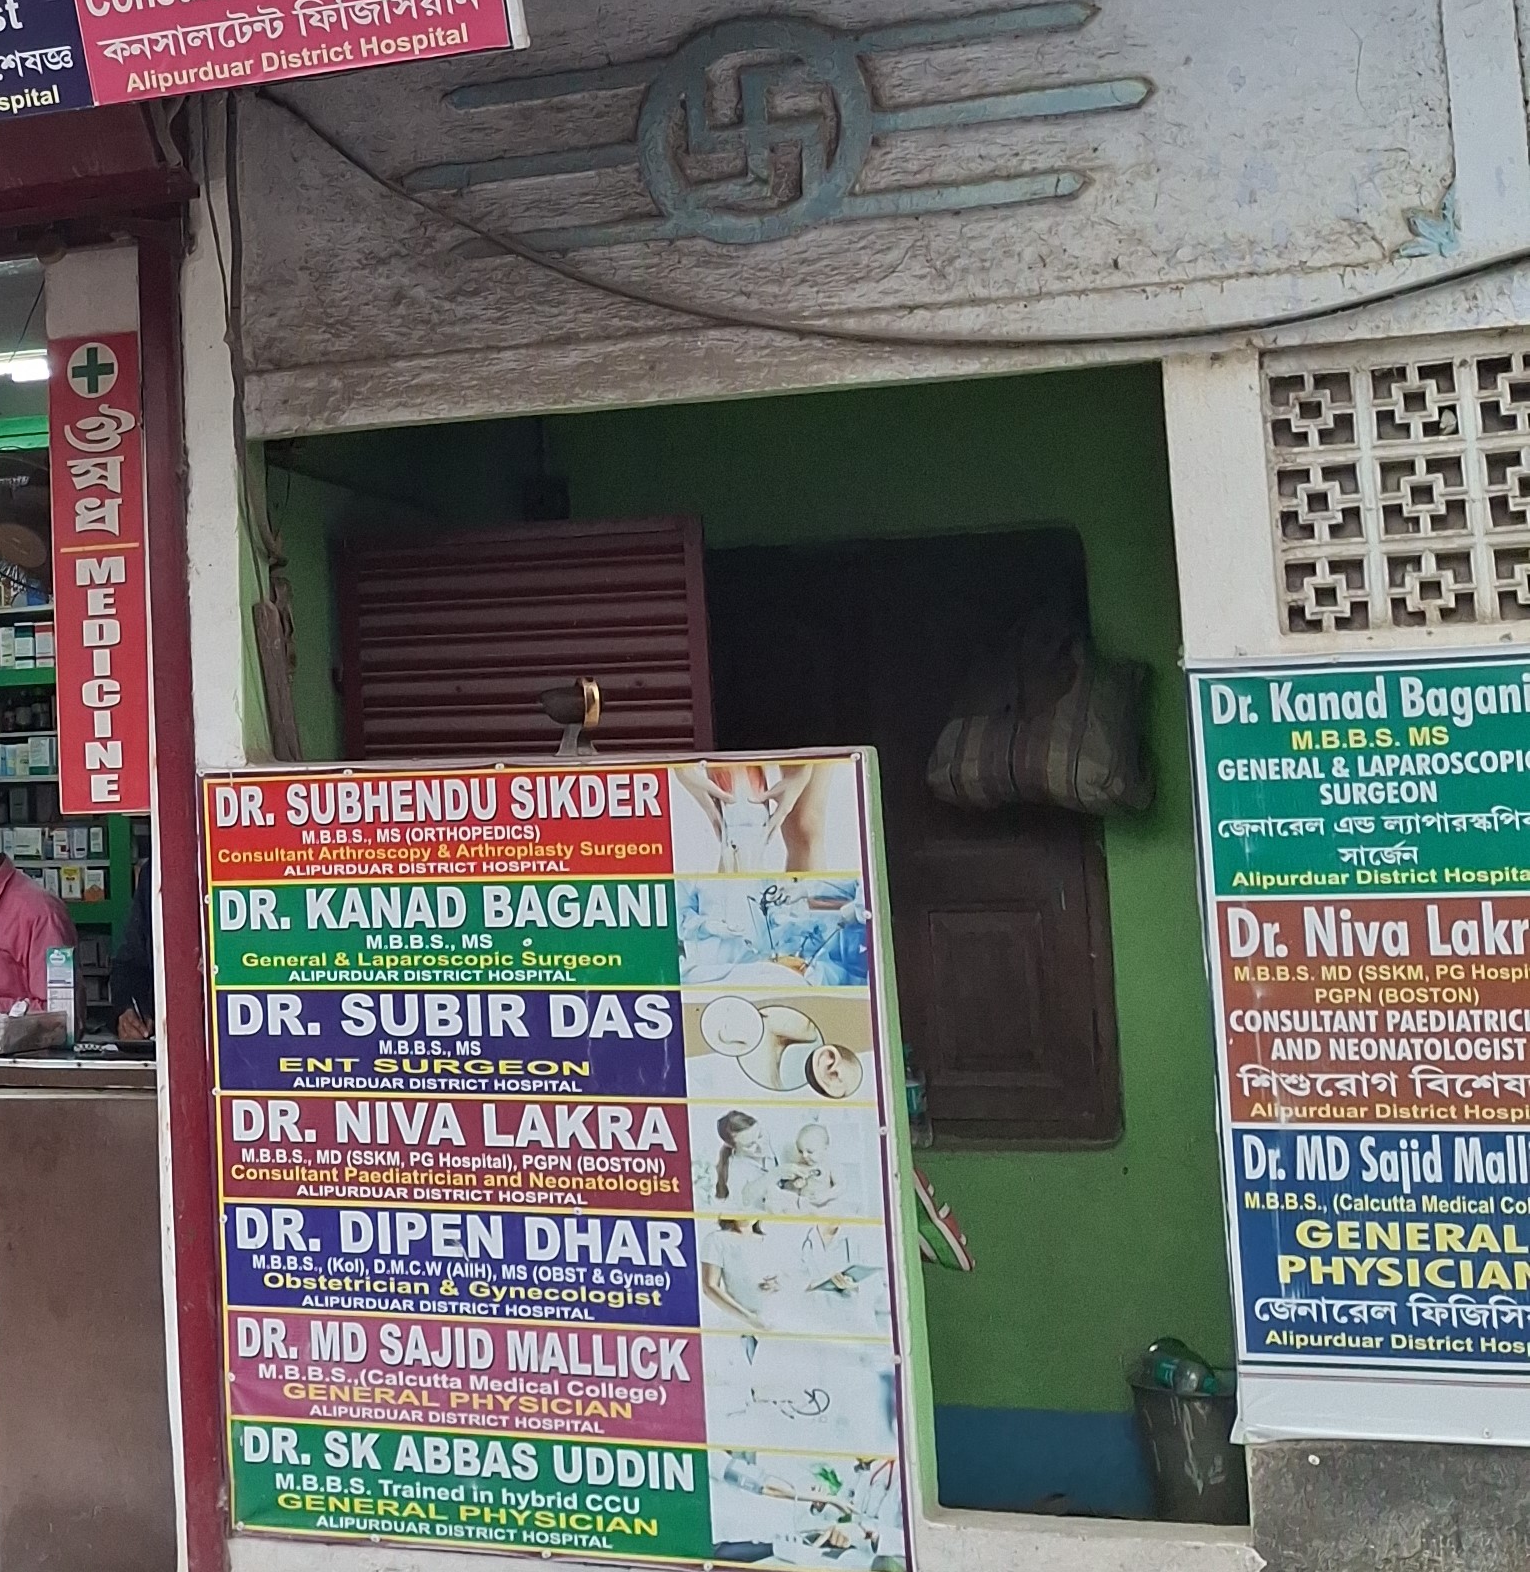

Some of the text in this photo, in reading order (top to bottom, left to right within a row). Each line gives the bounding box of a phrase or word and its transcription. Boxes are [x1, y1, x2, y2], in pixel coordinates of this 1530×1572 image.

[97, 6, 284, 64] কনসালটেন্ট
[75, 556, 127, 803] MEDICINE
[1210, 684, 1259, 724] Dr.
[1270, 676, 1388, 723] Kanad
[215, 773, 663, 828] DR. SUBHENDU SIKDER
[1320, 781, 1438, 805] SURGEON
[217, 841, 663, 864] Consultant Arthroscopy & Arthroplasty Surgeon
[302, 825, 541, 845] M.B.B.S., MS (ORTHOPEDICS)
[1338, 840, 1419, 866] সার্জেন
[284, 860, 570, 876] ALIPURDUAR DISTRICT HOSPITAL
[220, 883, 668, 932] DR. KANAD BAGANI
[227, 994, 674, 1040] DR. SUBIR DAS
[1315, 987, 1480, 1006] PGPN (BOSTON)
[280, 1057, 590, 1076] ENT SURGEON
[1271, 1037, 1526, 1061] AND NEONATOLOGIST
[1242, 1134, 1443, 1194] Dr. MD Sajid
[1244, 1192, 1494, 1215] M.B.B.S., (Calcutta Medical
[235, 1207, 687, 1268] DR. DIPEN DHAR
[243, 1428, 696, 1492] DR. SK ABBAS UDDIN
[275, 1472, 640, 1515] M.B.B.S. Trained in hybrid CCU
